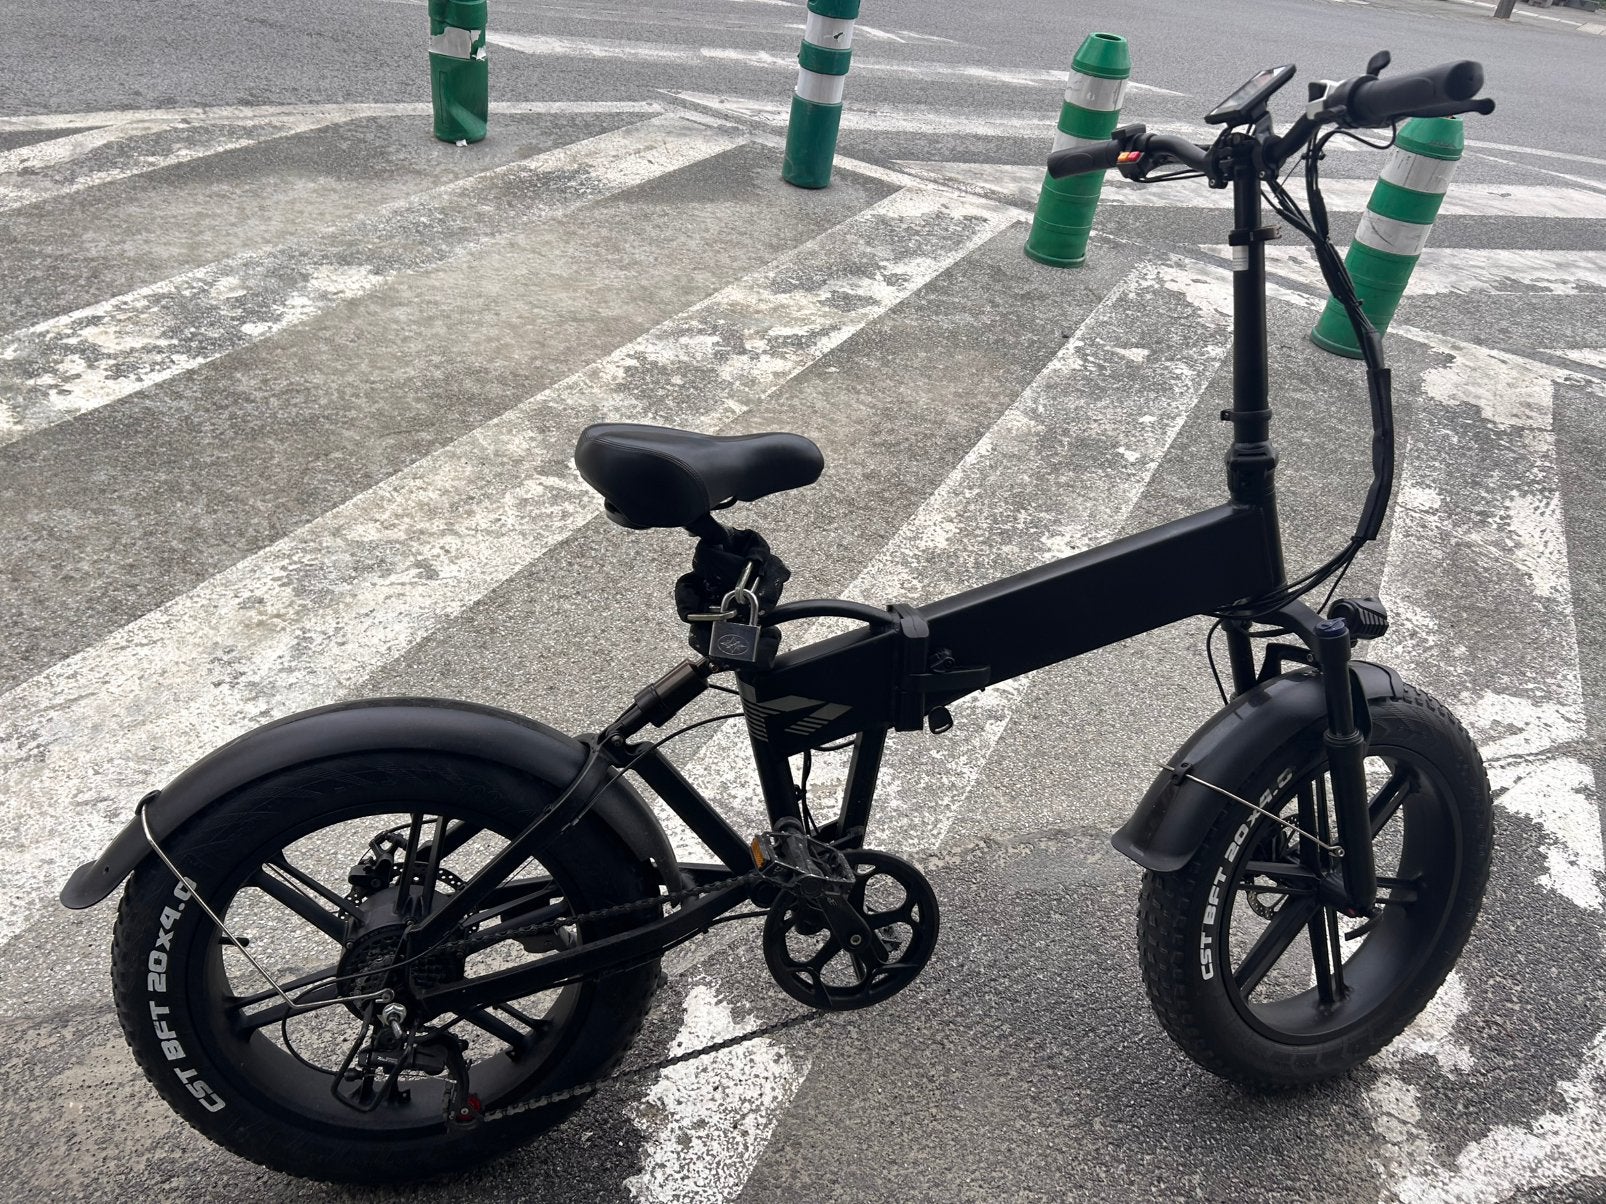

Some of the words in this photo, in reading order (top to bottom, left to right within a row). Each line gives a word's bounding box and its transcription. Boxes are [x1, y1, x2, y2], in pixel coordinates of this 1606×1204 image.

[1204, 867, 1228, 925] BFT
[1200, 932, 1214, 980] CST
[149, 1000, 186, 1061] BFT
[174, 1067, 226, 1113] CST
